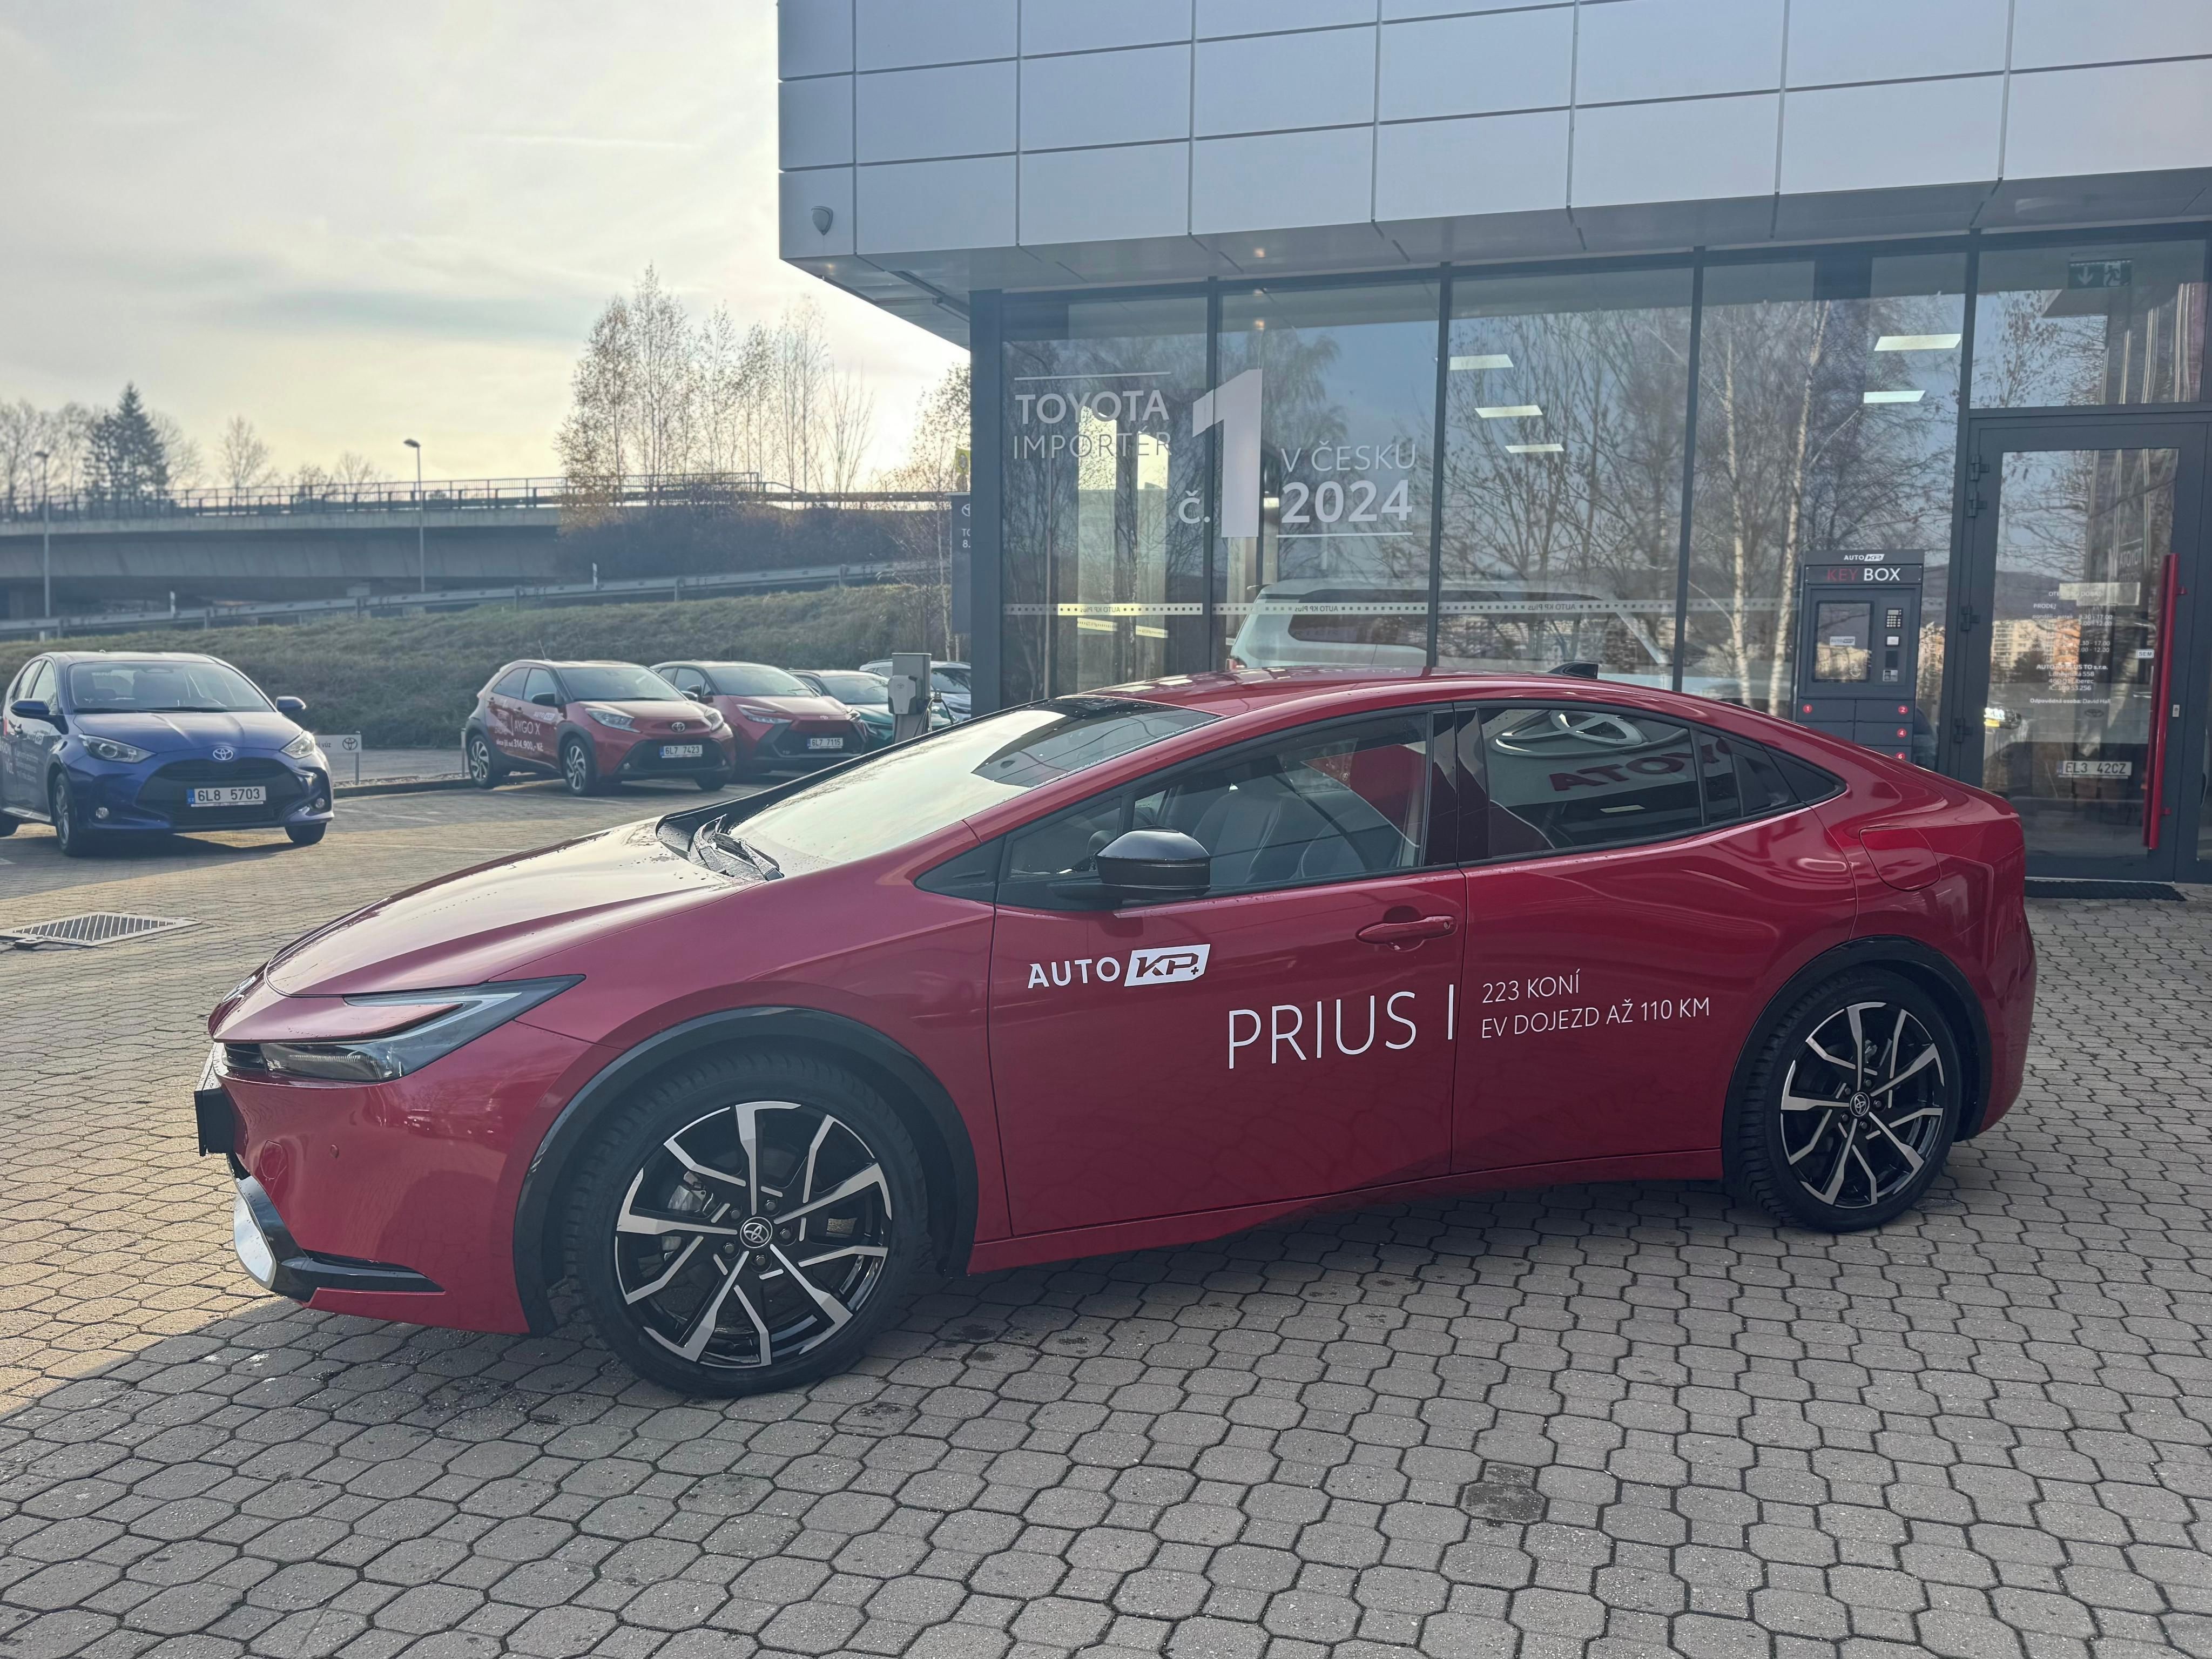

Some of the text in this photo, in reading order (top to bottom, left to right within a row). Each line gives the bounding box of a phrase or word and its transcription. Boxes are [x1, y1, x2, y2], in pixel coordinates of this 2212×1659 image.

[1015, 389, 1170, 425] TOYOTA
[1014, 425, 1172, 460] IMPORTÉR
[1192, 369, 1263, 537] 1
[1280, 440, 1417, 473] V ČESKU
[1280, 479, 1413, 524] 2024
[1826, 568, 1901, 581] KEY BOX
[514, 720, 534, 734] AYGO
[535, 723, 541, 735] X
[665, 746, 700, 754] 6L7 7423
[2065, 762, 2126, 774] EL3 42CZ
[198, 790, 221, 802] 6L8
[230, 788, 260, 801] 5703
[1028, 956, 1121, 989] AUTO
[1482, 968, 1580, 1003] 223 KONÍ
[1229, 990, 1417, 1070] PRIUS
[1481, 997, 1710, 1038] EV DOJEZD AŽ 110 KM
